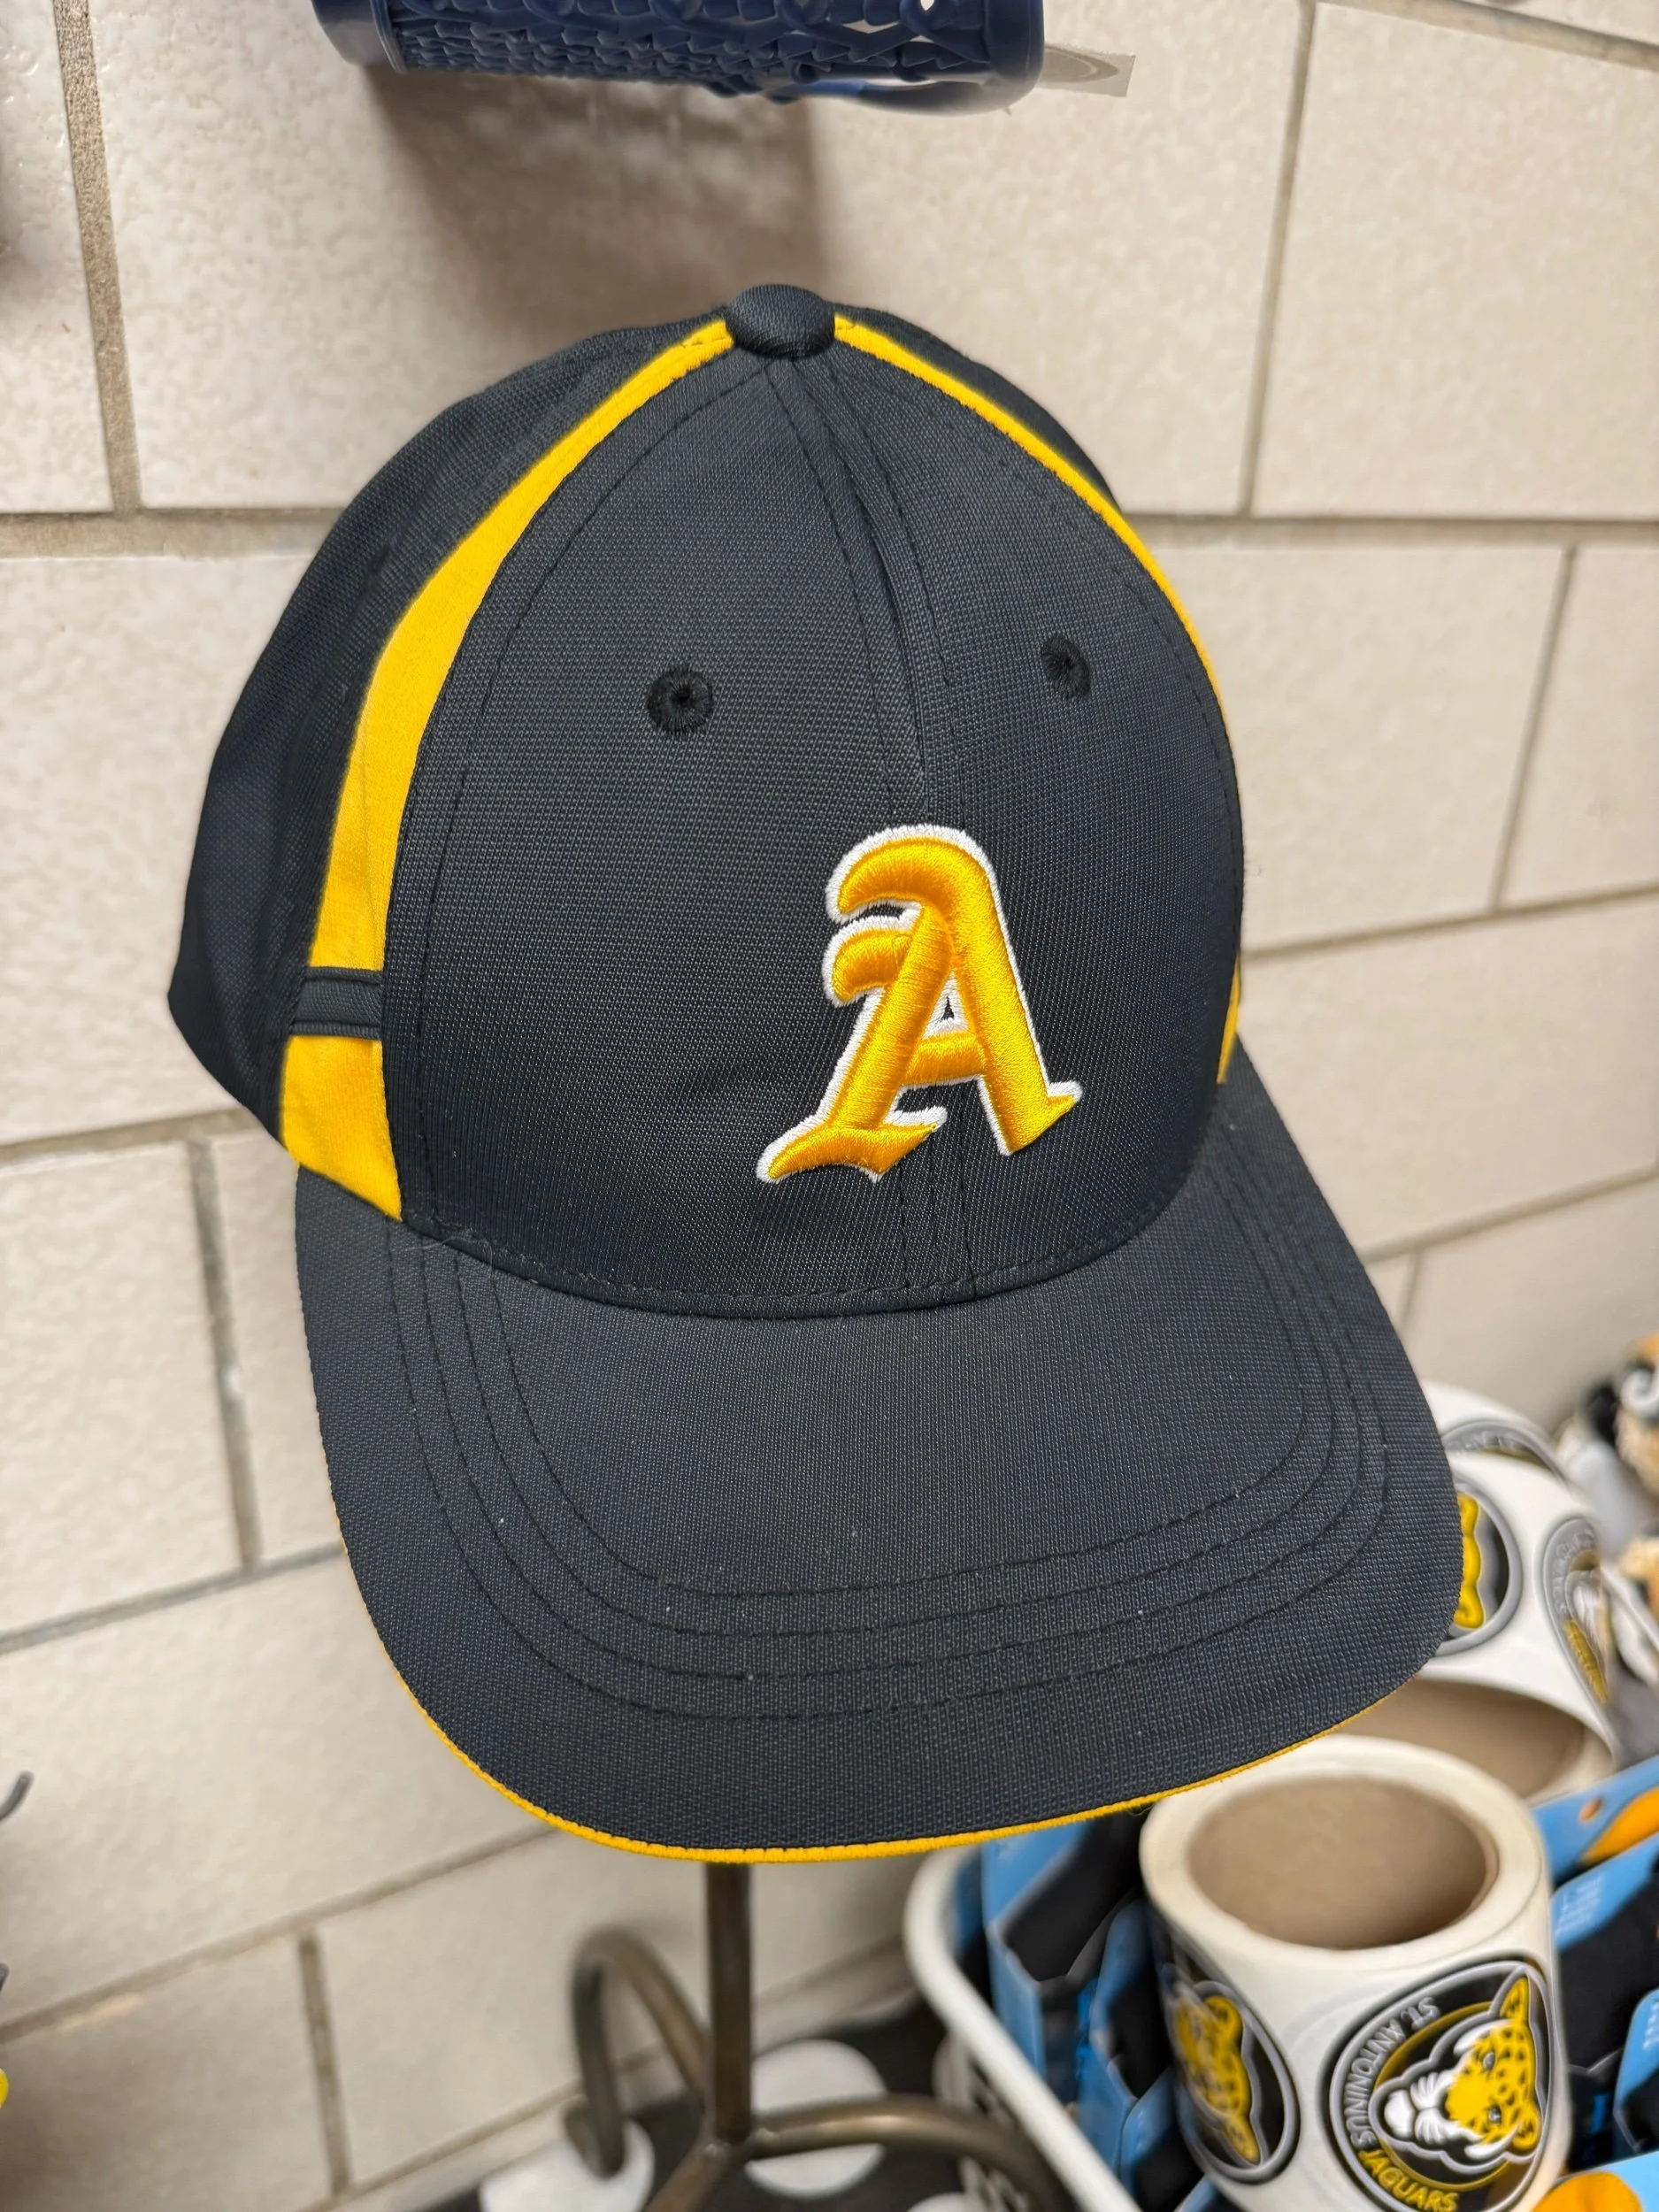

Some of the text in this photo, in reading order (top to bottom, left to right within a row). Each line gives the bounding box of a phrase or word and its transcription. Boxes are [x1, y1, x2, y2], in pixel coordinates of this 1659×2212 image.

[757, 824, 1082, 1182] A
[1344, 2017, 1405, 2147] ANTONINUS
[1358, 2149, 1459, 2212] JAGUARS
